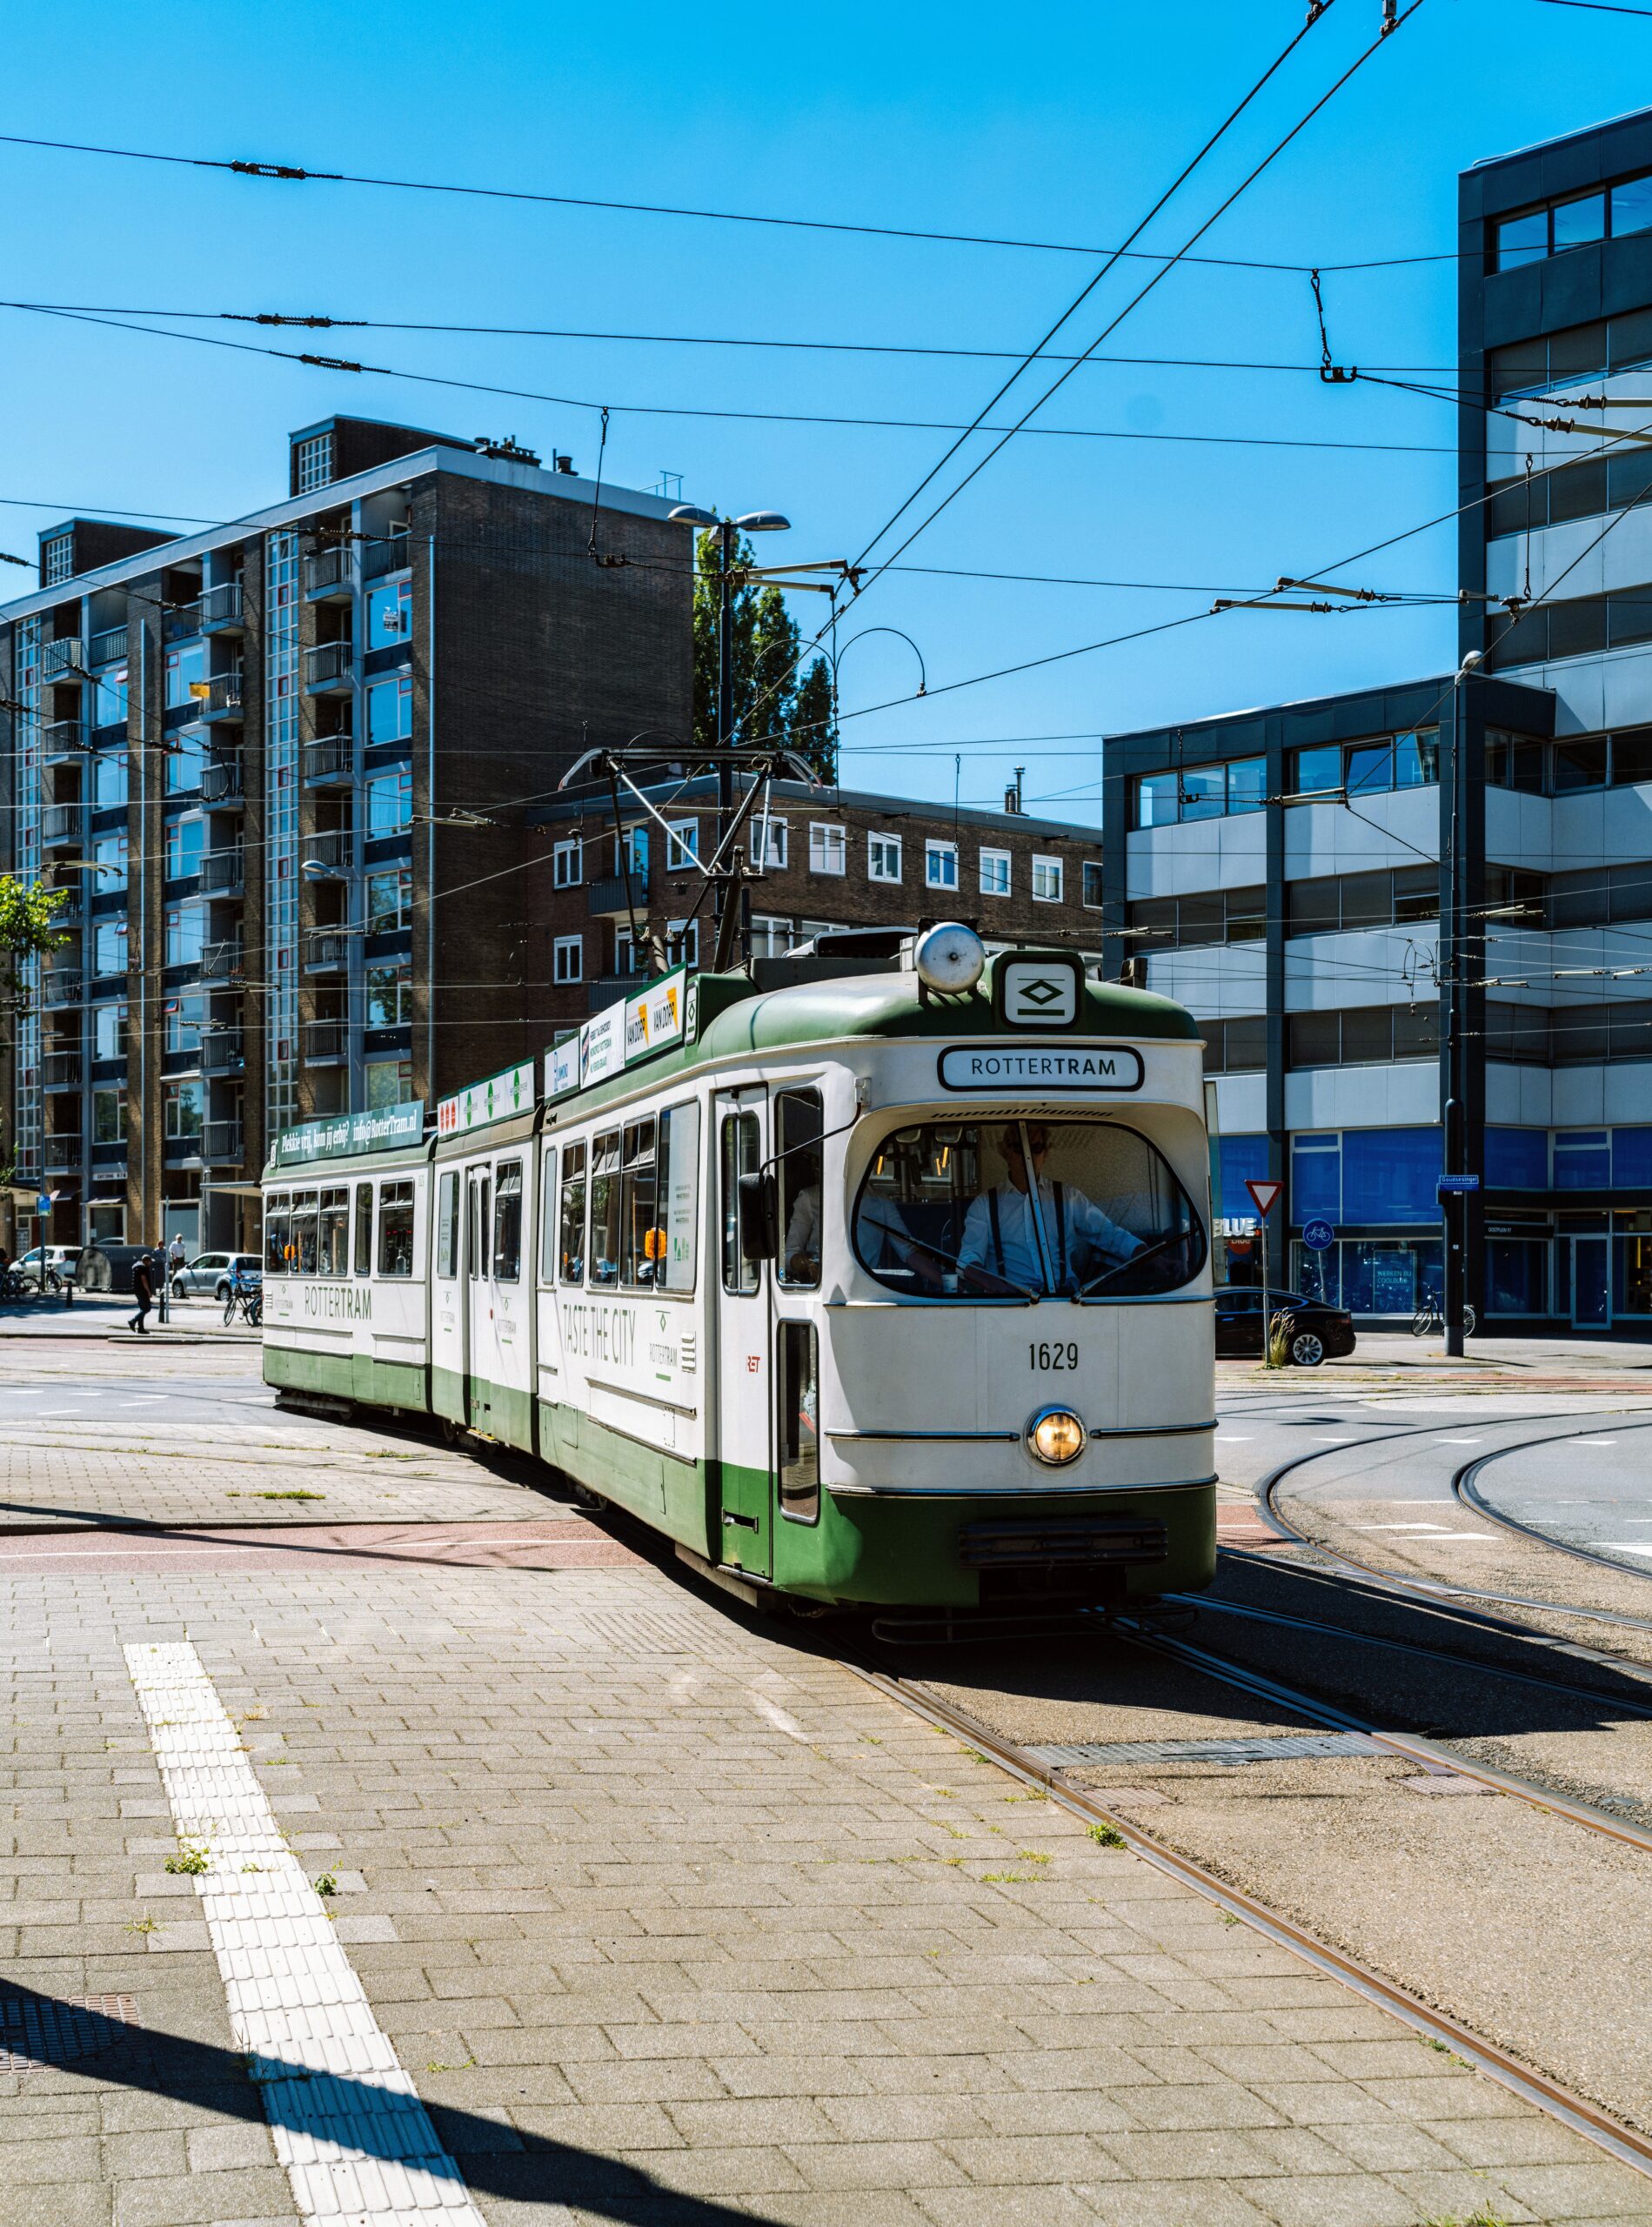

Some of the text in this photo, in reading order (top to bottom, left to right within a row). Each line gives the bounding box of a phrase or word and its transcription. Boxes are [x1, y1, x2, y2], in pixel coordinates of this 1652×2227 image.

[635, 1017, 645, 1042] DORP
[653, 1001, 674, 1033] VAN DORP
[972, 1058, 1116, 1076] ROTTERTRAM
[281, 1133, 300, 1153] Plekkie
[301, 1129, 312, 1154] vrij,
[313, 1129, 325, 1147] kom
[333, 1120, 349, 1148] erbij?
[352, 1109, 417, 1146] info@RotterTram.nl
[305, 1286, 371, 1320] ROTTERTRAM
[564, 1304, 636, 1367] TASTE THE CITY
[650, 1343, 677, 1367] ROTTERTRAM
[1029, 1342, 1078, 1370] 1629
